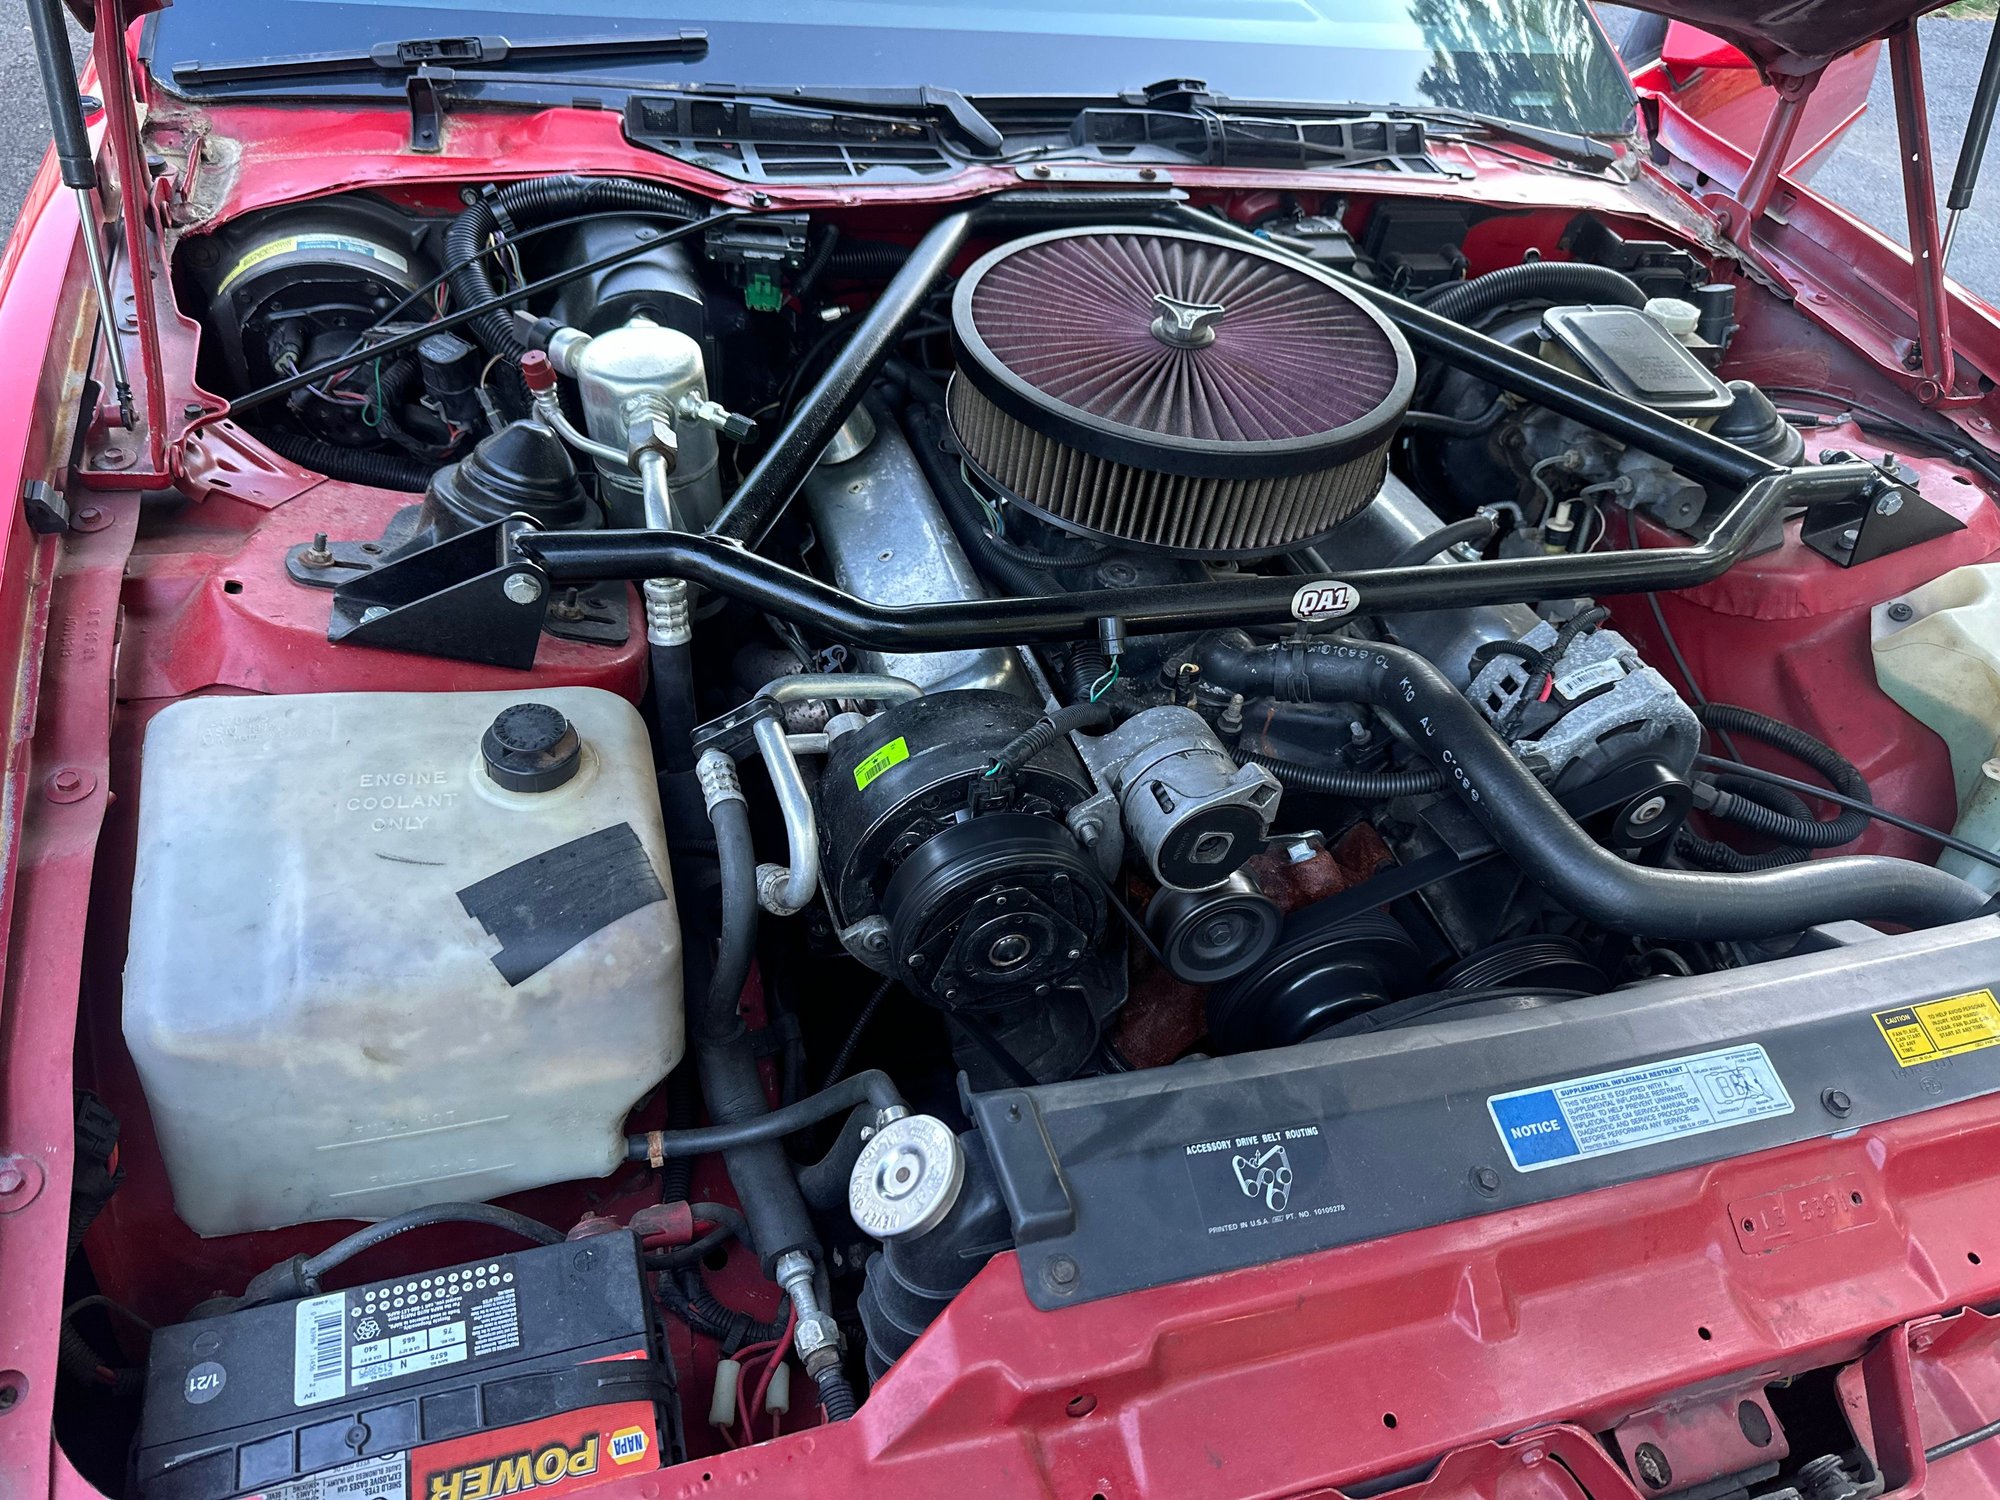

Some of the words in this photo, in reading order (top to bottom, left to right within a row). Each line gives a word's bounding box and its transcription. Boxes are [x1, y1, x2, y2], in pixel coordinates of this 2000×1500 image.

[1298, 587, 1349, 617] QA1
[1400, 676, 1416, 702] K10
[1420, 716, 1436, 737] AU
[359, 771, 449, 788] ENGINE
[346, 793, 458, 811] COOLANT
[371, 816, 430, 832] ONLY
[1935, 1011, 1948, 1019] HELP
[1948, 1008, 1963, 1016] AVOID
[1963, 1002, 1987, 1013] PERSONAL
[1950, 1015, 1962, 1023] KEEP
[1885, 1014, 1911, 1025] CAUTION
[1964, 1018, 1979, 1026] BLADE
[1938, 1031, 1954, 1039] START
[1962, 1026, 1972, 1034] ANY
[1560, 1082, 1610, 1095] SUPPLEMENTAL
[1611, 1073, 1647, 1085] INFLATABLE
[1648, 1066, 1682, 1077] RESTRAINT
[1563, 1099, 1579, 1107] THIS
[1579, 1093, 1606, 1103] VEHICLE
[1614, 1085, 1645, 1096] EQUIPPED
[1567, 1100, 1615, 1114] SUPPLEMENTAL
[1616, 1091, 1650, 1104] INFLATABLE
[1651, 1084, 1683, 1096] RESTRAINT
[1607, 1105, 1623, 1113] HELP
[1624, 1098, 1652, 1109] PREVENT
[1654, 1091, 1688, 1103] UNWANTED
[1607, 1113, 1621, 1121] SEE
[1633, 1105, 1659, 1116] SERVICE
[1660, 1100, 1685, 1109] MANUAL
[1686, 1096, 1700, 1104] FOR
[1511, 1119, 1559, 1138] NOTICE
[1577, 1123, 1614, 1136] DIAGNOSTIC
[1630, 1113, 1656, 1124] SERVICE
[1657, 1104, 1699, 1117] PROCEDURES
[1580, 1132, 1606, 1143] BEFORE
[1606, 1123, 1648, 1137] PERFORMING
[1649, 1120, 1661, 1128] ANY
[1663, 1114, 1690, 1125] SERVICE.
[1186, 1140, 1230, 1154] ACCESSORY
[1235, 1135, 1258, 1146] DRIVE
[1261, 1132, 1280, 1142] BELT
[1285, 1126, 1318, 1138] ROUTING
[863, 1208, 900, 1230] NEVER
[1208, 1223, 1237, 1233] PRINTED
[1314, 1204, 1345, 1214] 10105278
[432, 1315, 450, 1323] Recycle
[364, 1344, 377, 1353] 540
[402, 1336, 415, 1344] 665
[400, 1359, 406, 1368] N
[430, 1351, 447, 1360] 6575
[190, 1373, 220, 1392] 1/21
[303, 1391, 315, 1399] 12V
[612, 1433, 644, 1456] NAPA
[355, 1466, 385, 1481] BLINDNESS
[384, 1464, 402, 1475] CAUSE
[430, 1433, 600, 1500] POWER
[346, 1474, 355, 1483] OR
[348, 1479, 369, 1492] GASES
[369, 1474, 402, 1487] EXPLOSIVE
[337, 1484, 348, 1494] CAN
[381, 1481, 402, 1494] SHIELD
